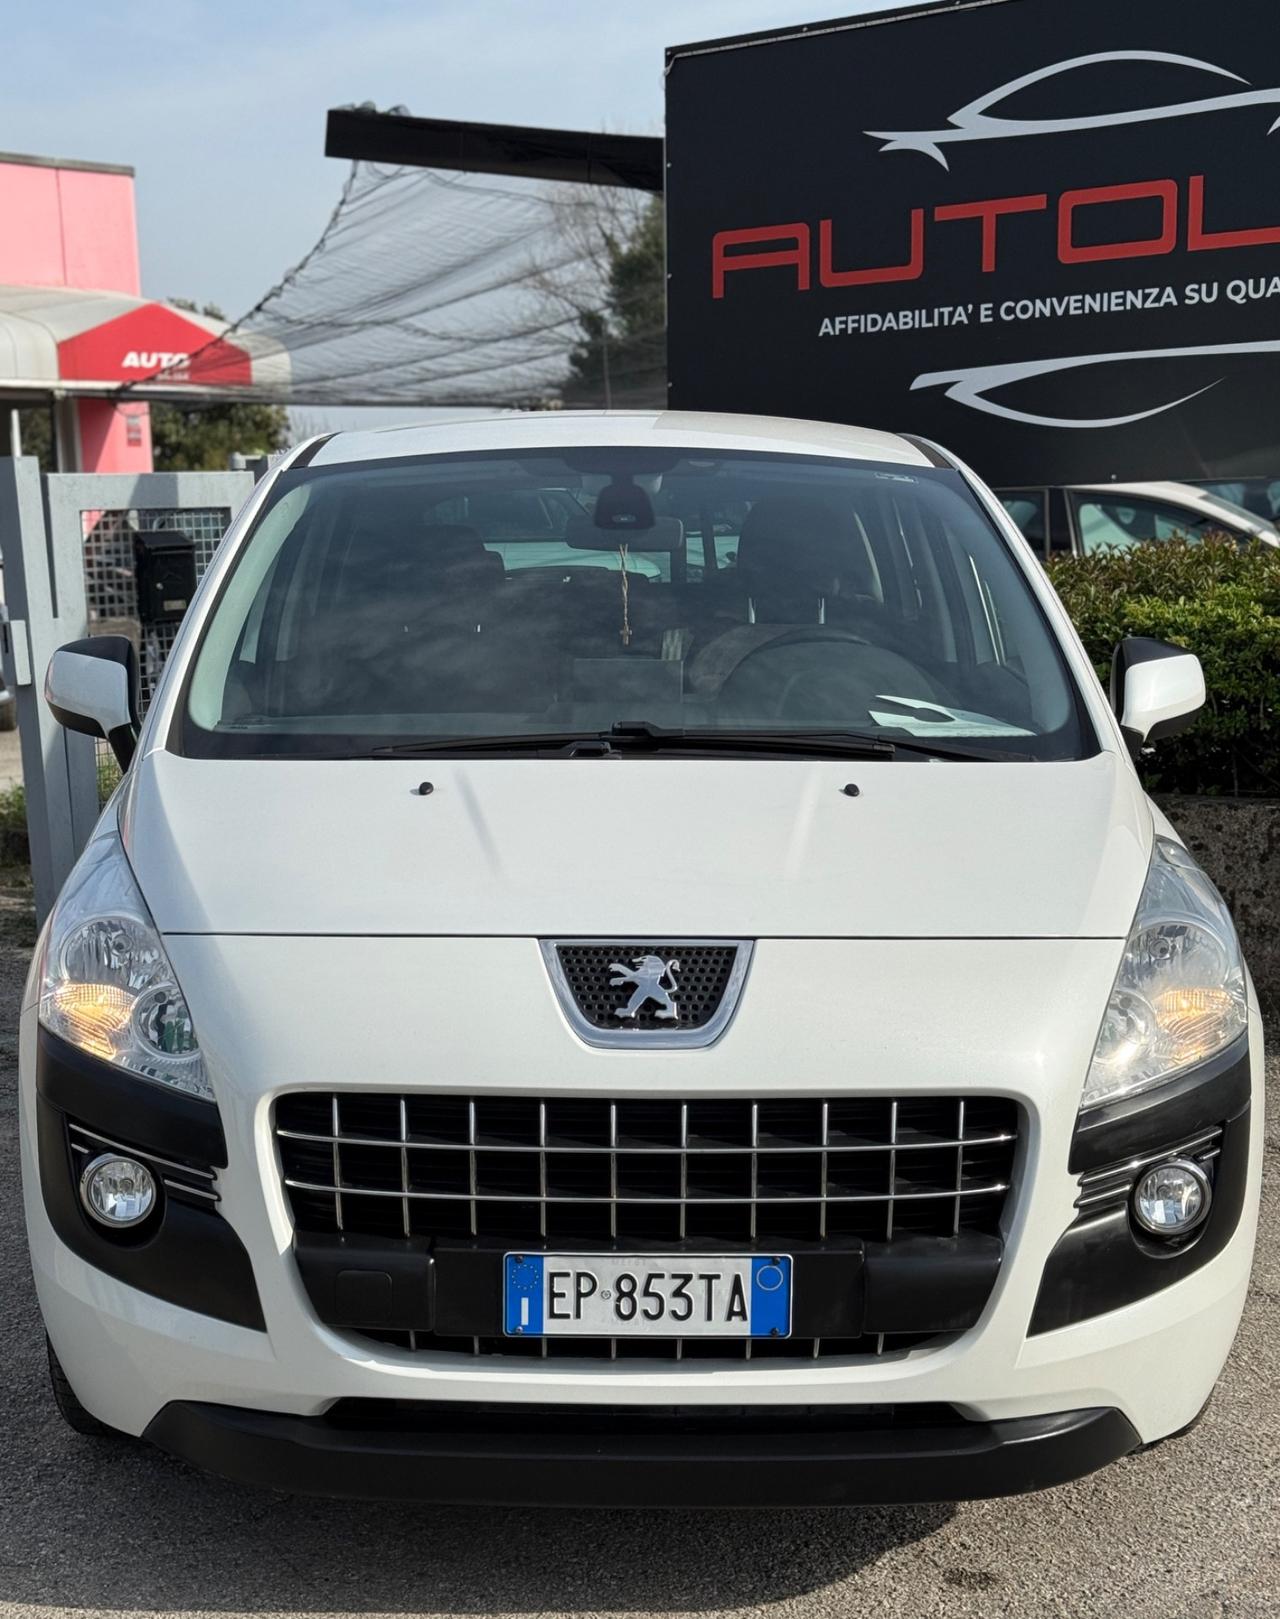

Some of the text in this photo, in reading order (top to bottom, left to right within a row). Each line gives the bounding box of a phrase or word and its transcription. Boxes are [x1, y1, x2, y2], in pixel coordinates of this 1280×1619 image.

[980, 303, 993, 323] E
[1000, 286, 1178, 321] CONVENIENZA
[1184, 282, 1218, 305] SU
